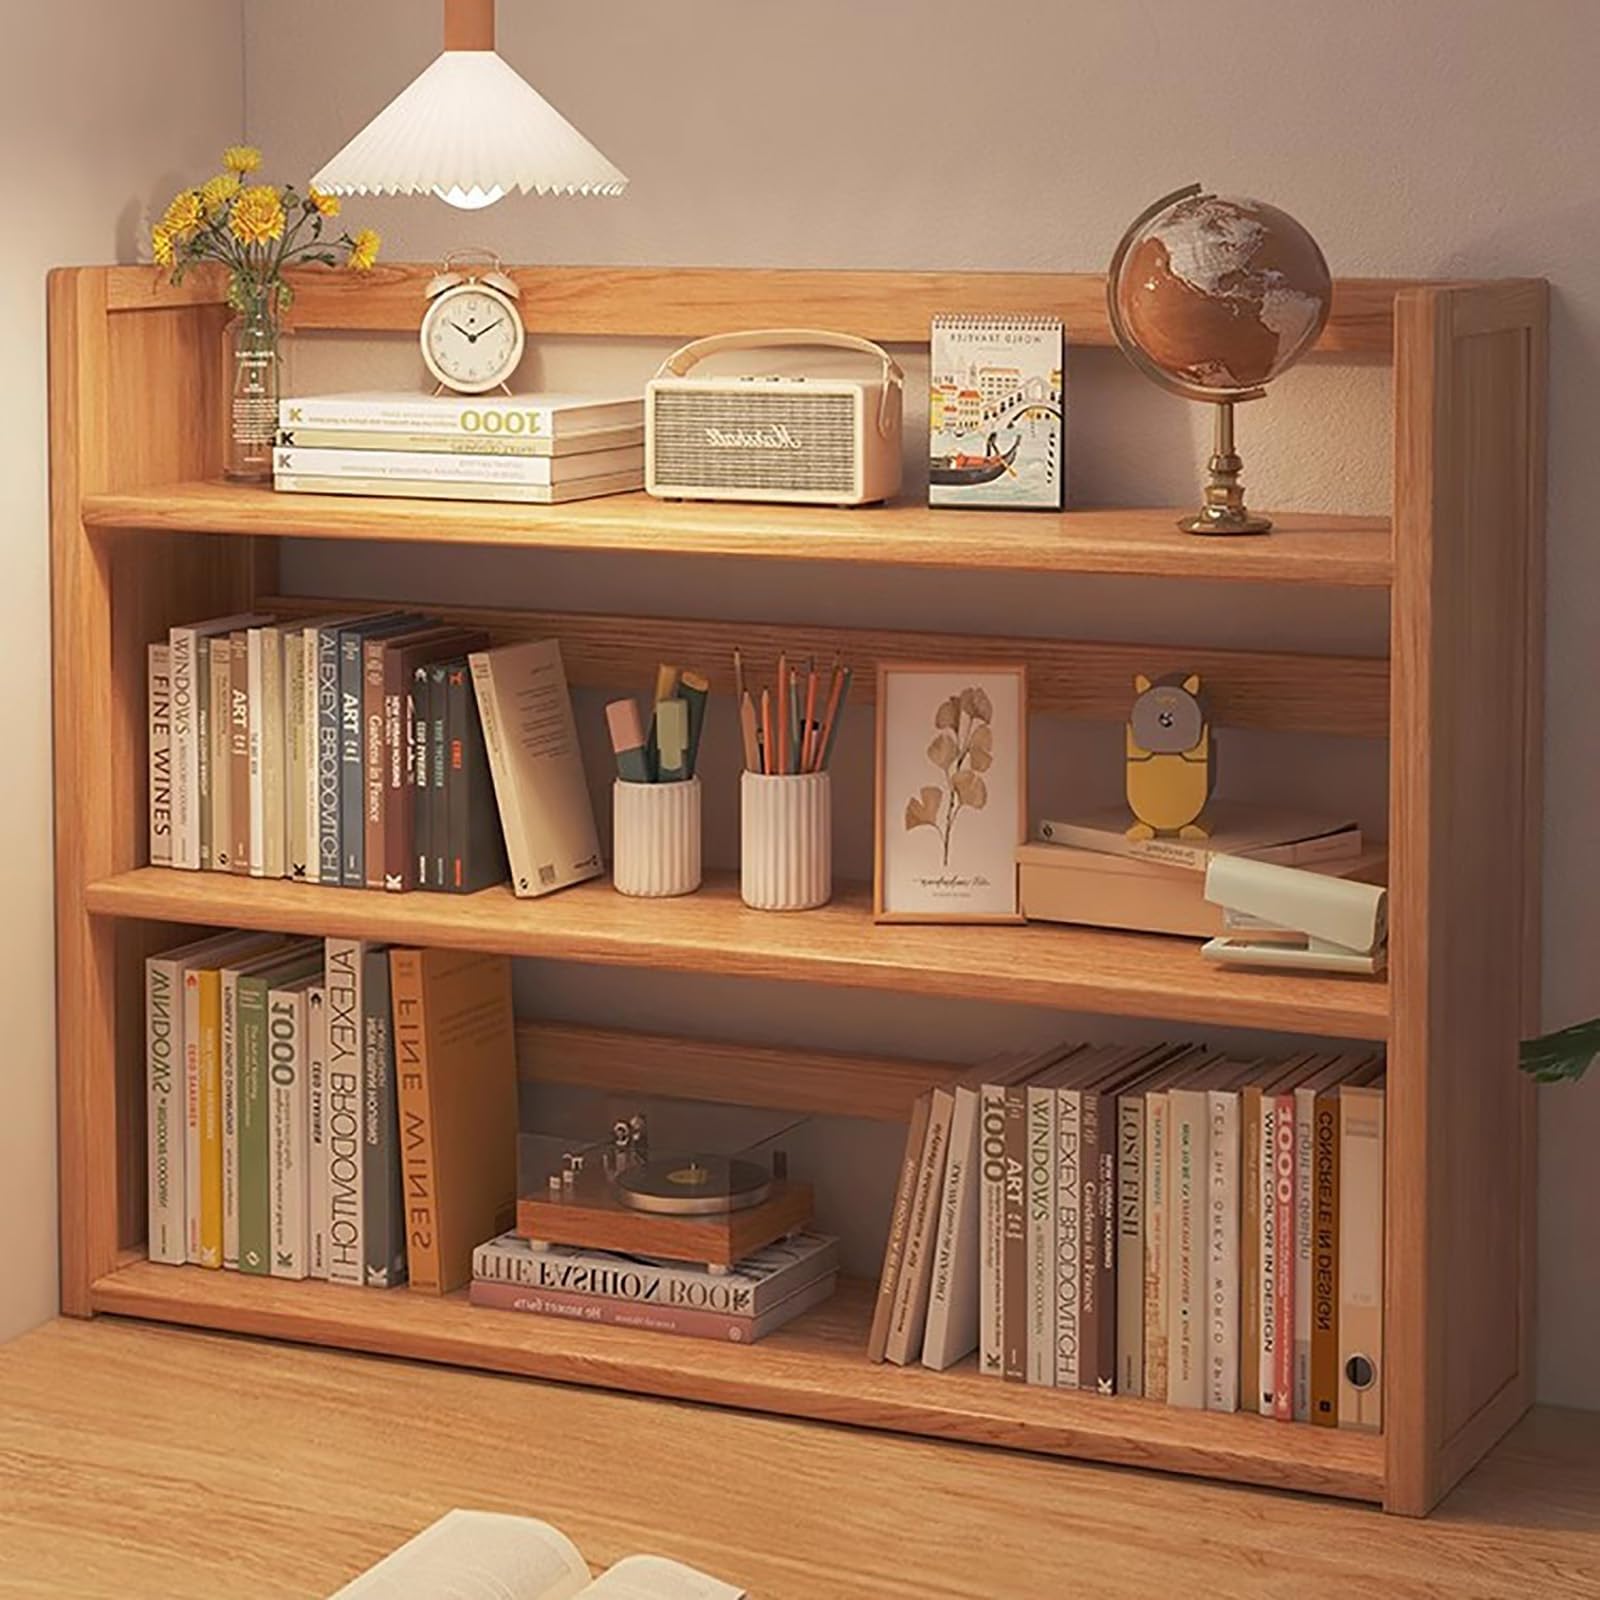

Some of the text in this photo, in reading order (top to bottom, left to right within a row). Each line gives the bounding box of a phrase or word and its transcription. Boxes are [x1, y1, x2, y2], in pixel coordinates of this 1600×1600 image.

[461, 411, 541, 433] 1000
[175, 637, 191, 736] WINDOWS
[232, 690, 248, 729] ART
[343, 693, 359, 734] ART
[153, 676, 170, 836] FINE WINES
[322, 634, 339, 869] ALEXEY BRODOVITCH
[369, 715, 382, 822] Gardens in France
[984, 1095, 1006, 1182] 1000
[1007, 1158, 1023, 1205] ART
[1031, 1099, 1050, 1221] WINDOWS
[1122, 1106, 1140, 1237] LOST FISH
[1277, 1107, 1293, 1203] 1000
[1059, 1098, 1078, 1372] ALEXEY BRODOVITCH
[1083, 1182, 1095, 1312] Gardens in France
[1263, 1111, 1274, 1354] WHITE COLOR IN DESIGN
